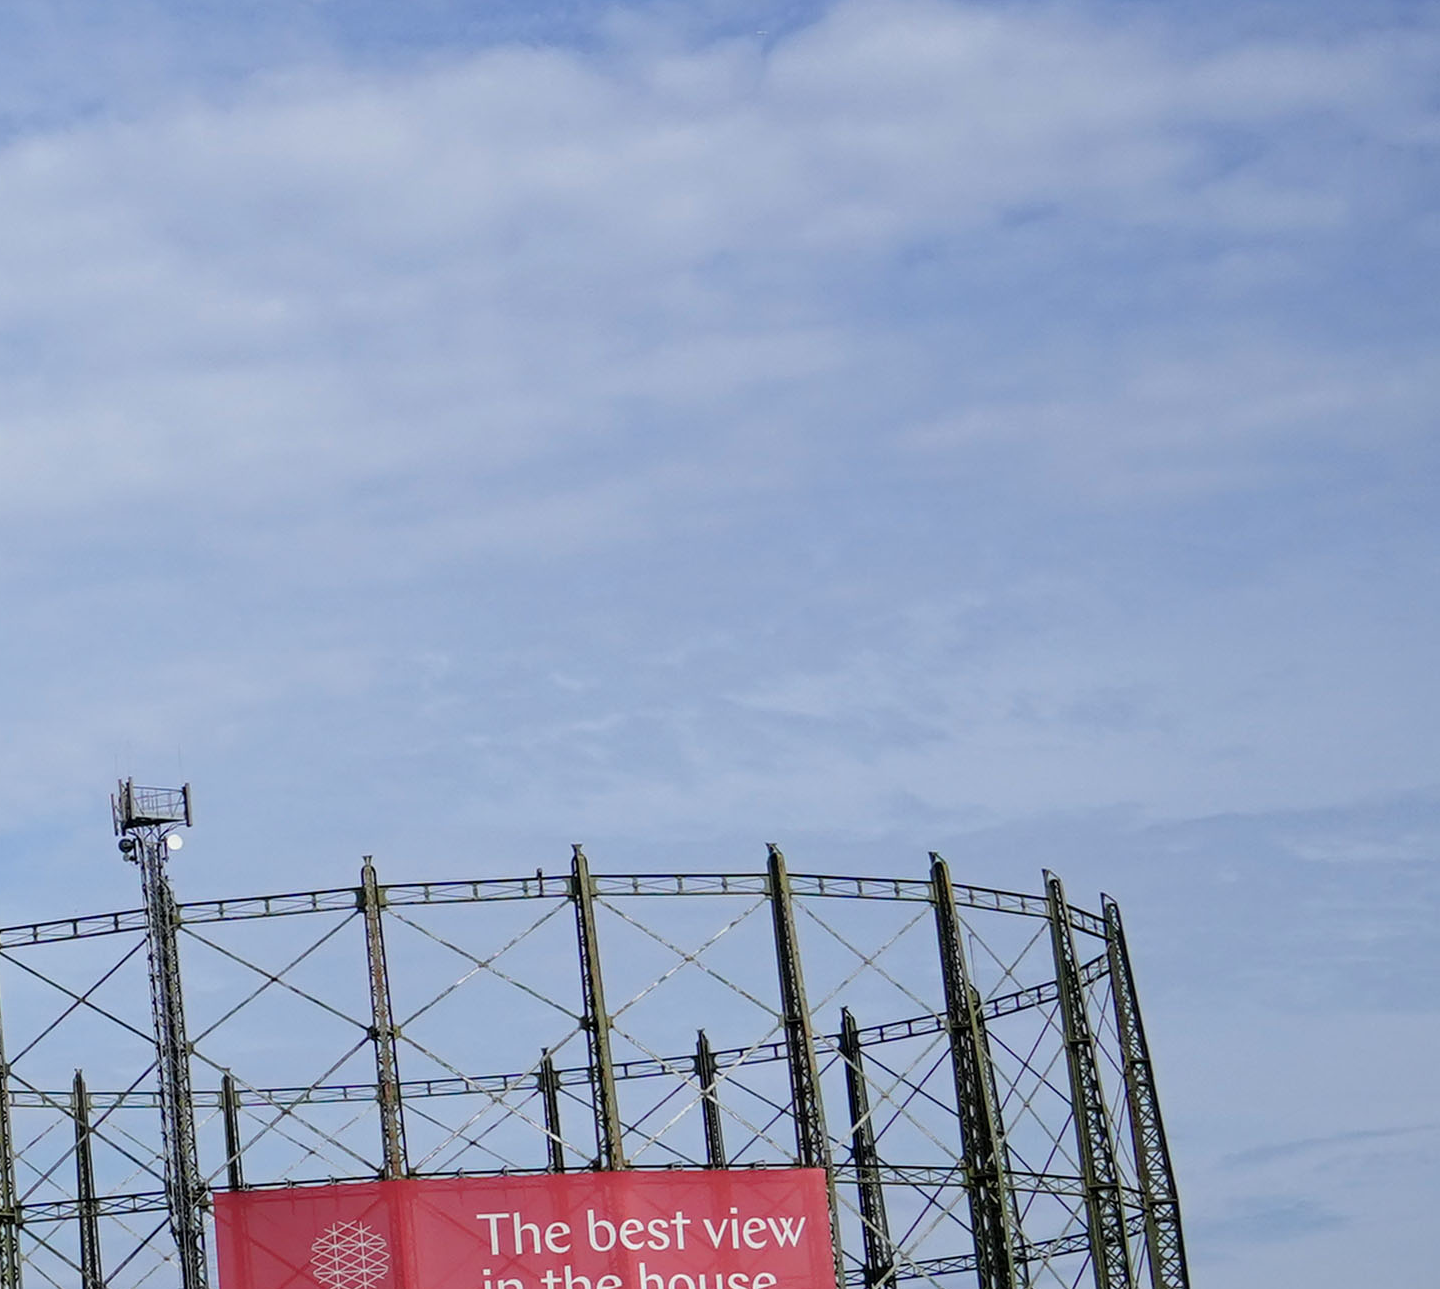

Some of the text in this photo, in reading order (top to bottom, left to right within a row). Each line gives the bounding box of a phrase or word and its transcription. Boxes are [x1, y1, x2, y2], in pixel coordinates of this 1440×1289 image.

[476, 1207, 806, 1255] The best view
